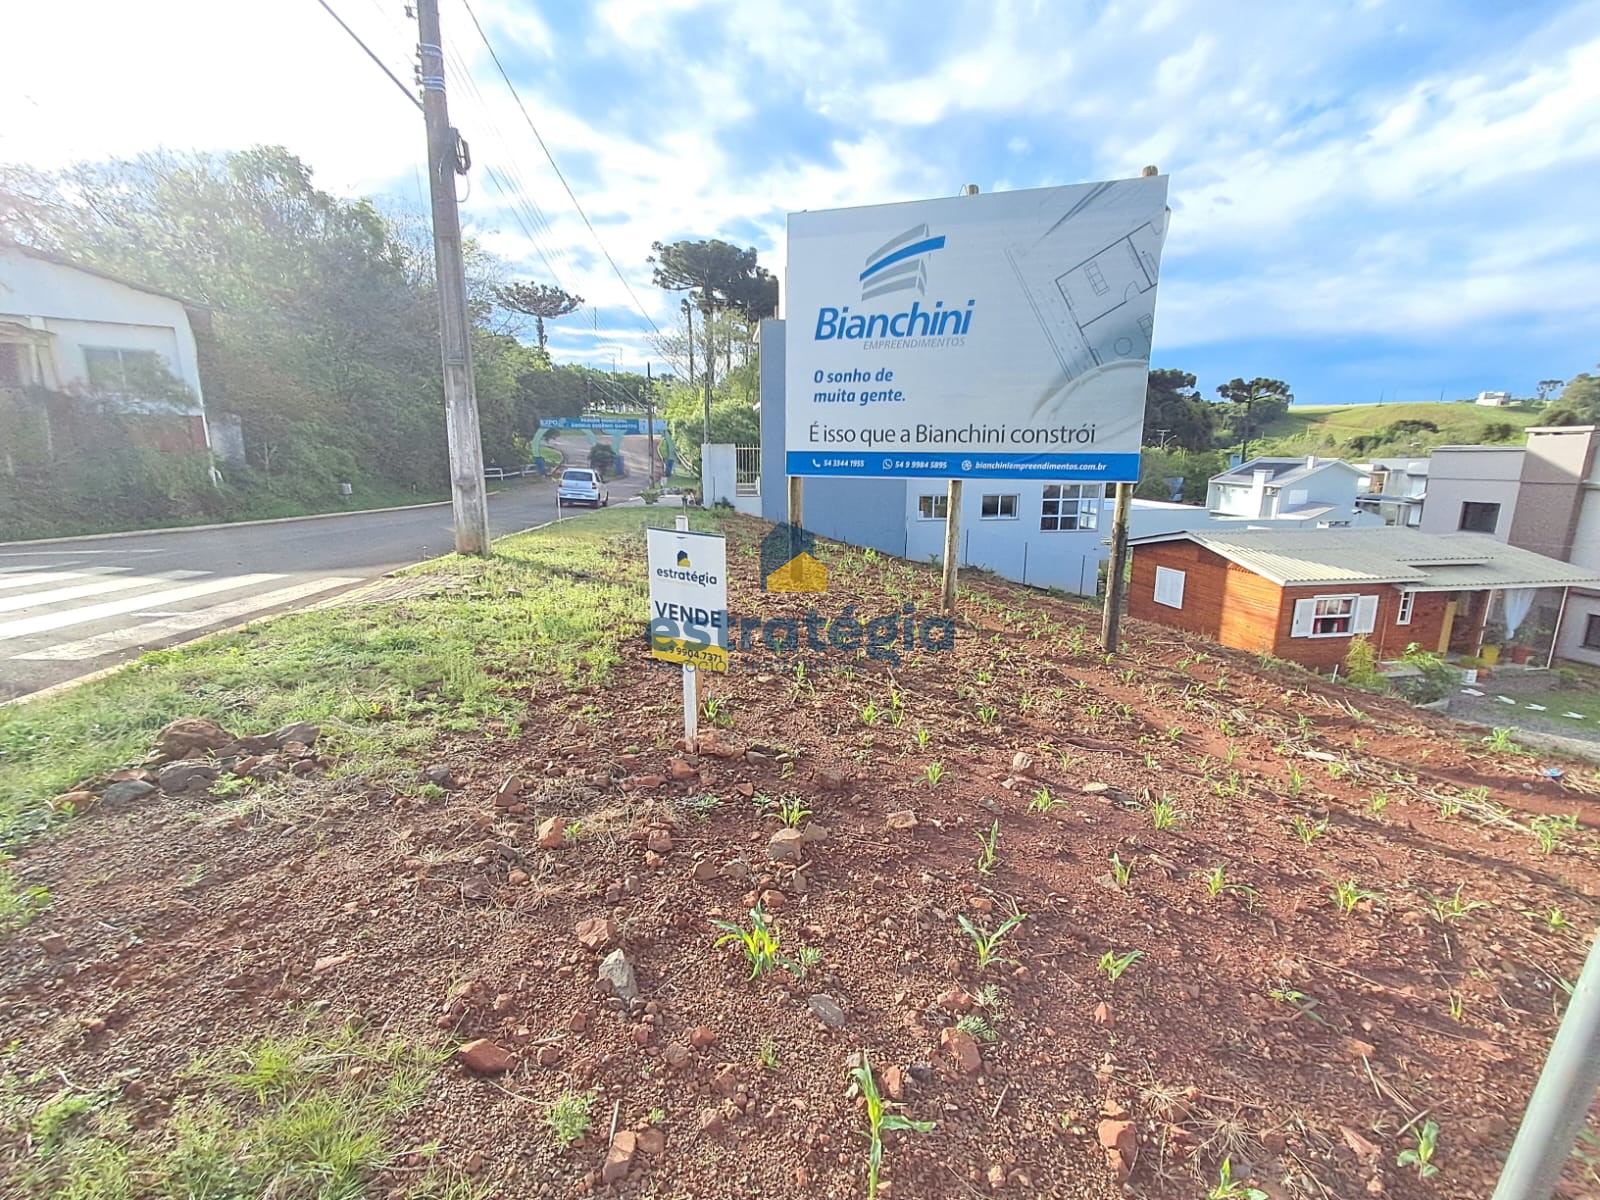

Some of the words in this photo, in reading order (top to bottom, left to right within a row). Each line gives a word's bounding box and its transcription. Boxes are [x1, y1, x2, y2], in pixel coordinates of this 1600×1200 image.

[815, 299, 975, 341] Bianchini
[863, 337, 966, 350] EMPREENDIMENTOS
[814, 370, 824, 383] O
[827, 368, 871, 383] sonho
[875, 368, 893, 382] de
[813, 388, 855, 403] muita
[860, 388, 906, 406] gente.
[809, 421, 819, 442] É
[823, 425, 856, 442] isso
[860, 428, 896, 447] que
[900, 428, 911, 442] a
[916, 424, 1006, 443] Bianchini
[1010, 424, 1096, 443] constrói
[823, 459, 832, 467] 54
[895, 460, 904, 468] 54
[975, 460, 1107, 471] bianchiniempreendimentos.com.br
[656, 568, 718, 587] estratégia
[655, 600, 722, 628] VENDE
